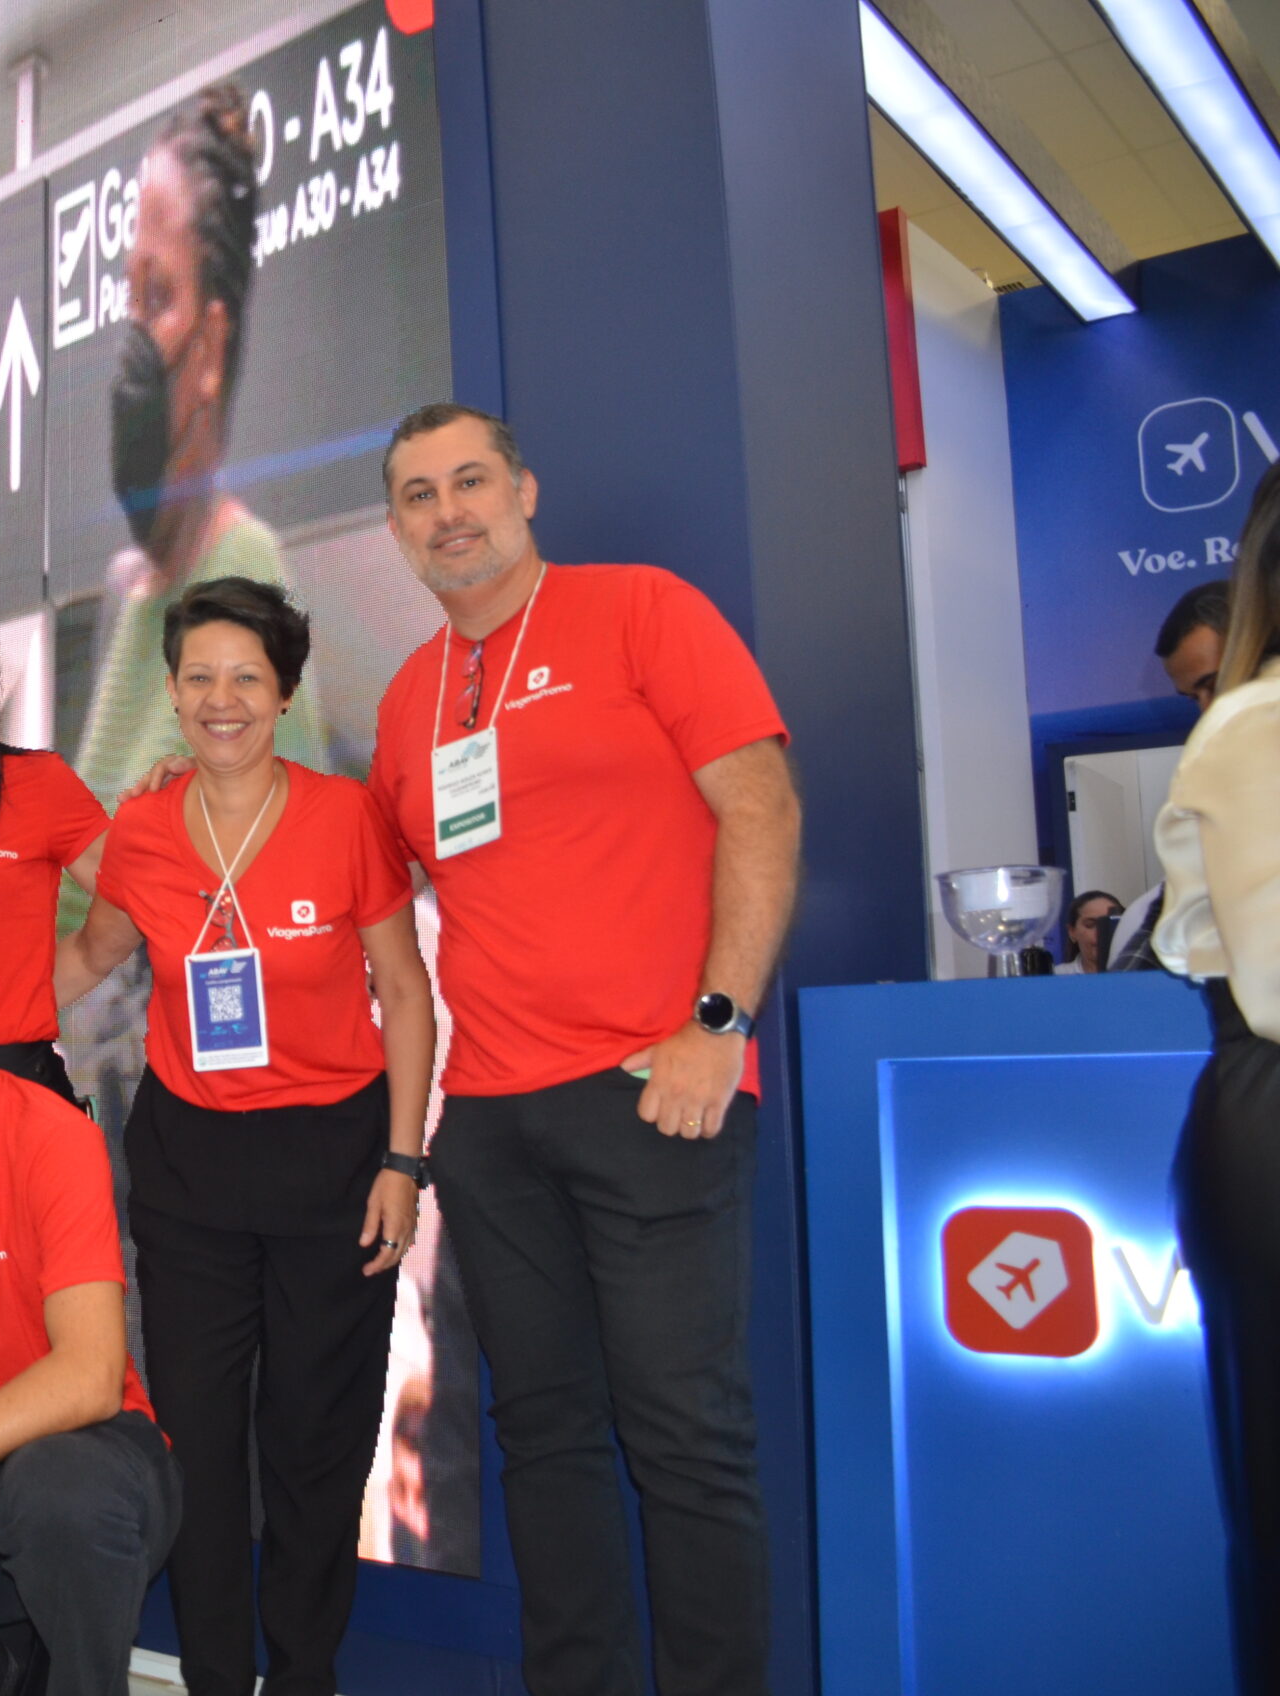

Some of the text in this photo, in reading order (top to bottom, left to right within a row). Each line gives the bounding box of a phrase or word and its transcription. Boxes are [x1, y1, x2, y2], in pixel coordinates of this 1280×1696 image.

[98, 168, 140, 260] Ga
[309, 25, 394, 161] A34
[290, 170, 337, 243] A30
[352, 140, 401, 217] A34
[1117, 548, 1197, 576] Voe.
[1111, 1246, 1182, 1325] V
